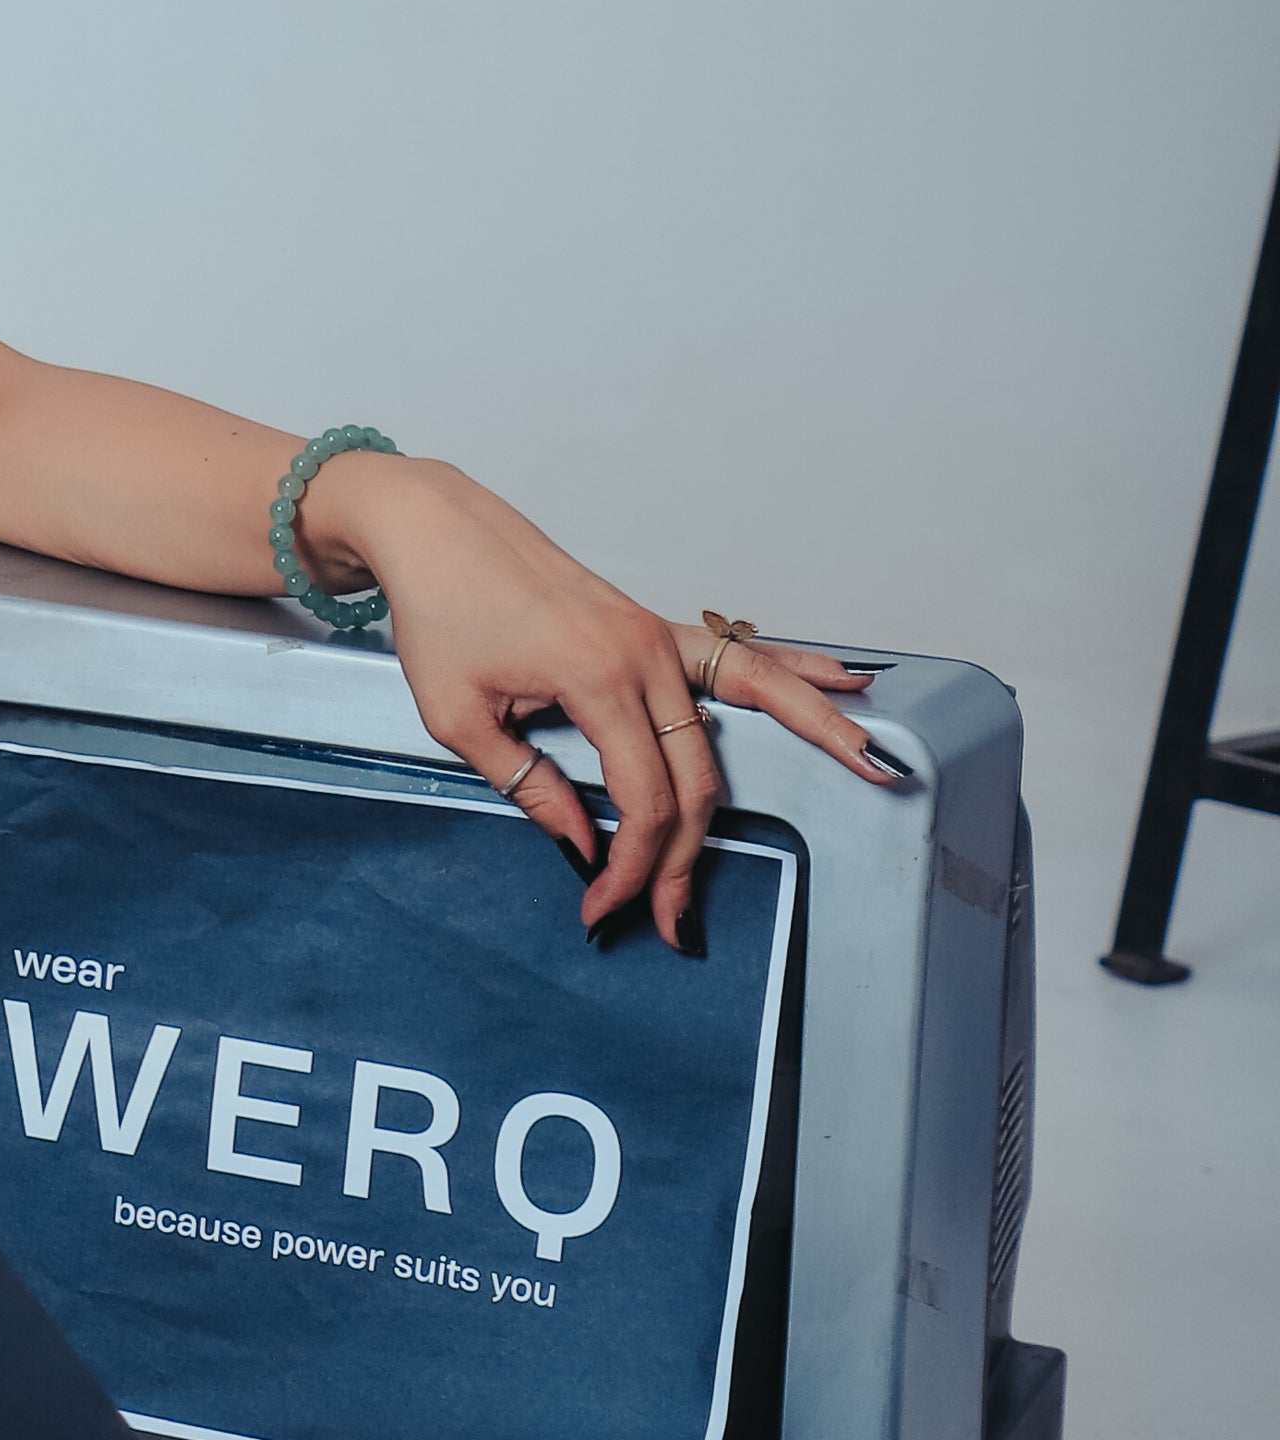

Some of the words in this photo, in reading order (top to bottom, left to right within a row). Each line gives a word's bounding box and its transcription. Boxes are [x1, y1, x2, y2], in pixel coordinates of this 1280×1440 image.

[13, 948, 125, 991] wear
[2, 998, 622, 1262] WERQ
[114, 1195, 263, 1250] because
[271, 1230, 385, 1273] power
[393, 1255, 481, 1292] suits
[490, 1272, 557, 1308] you
